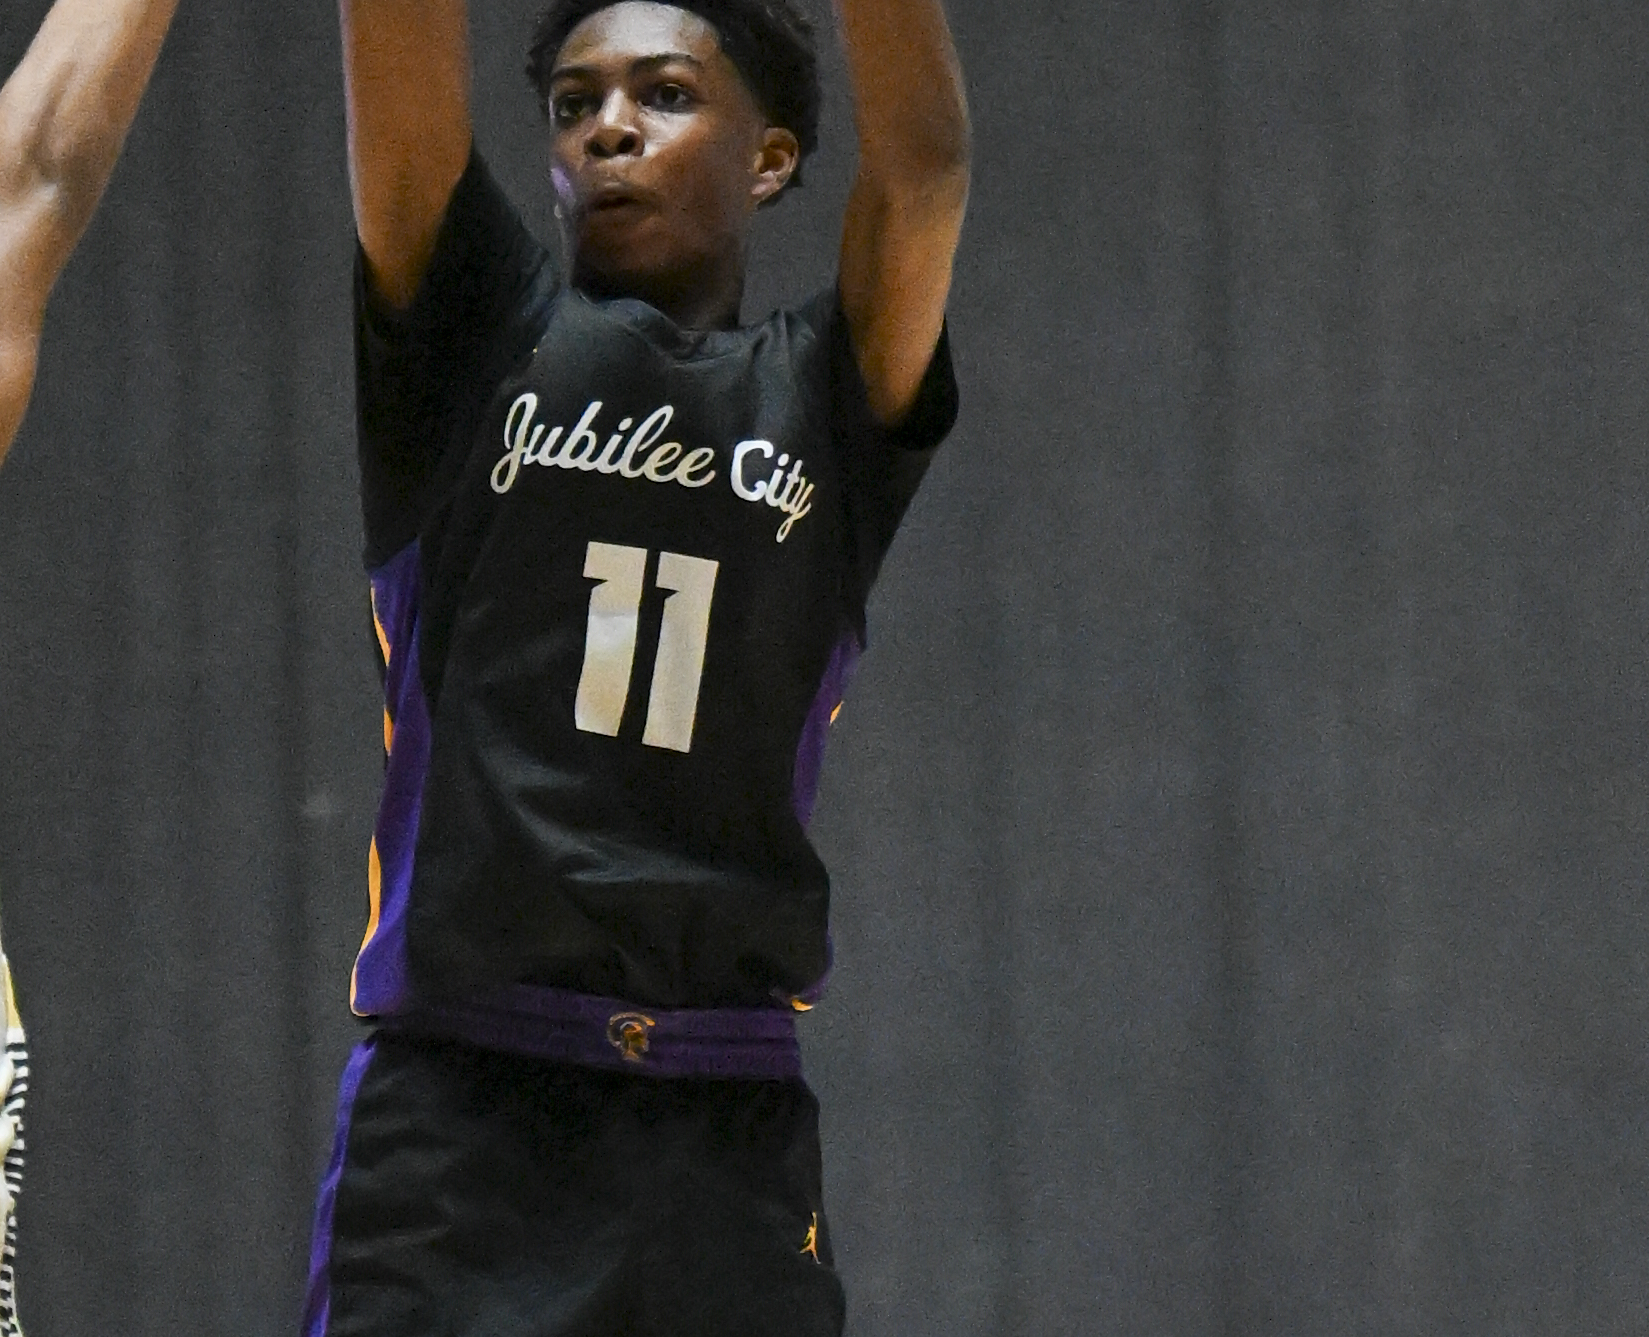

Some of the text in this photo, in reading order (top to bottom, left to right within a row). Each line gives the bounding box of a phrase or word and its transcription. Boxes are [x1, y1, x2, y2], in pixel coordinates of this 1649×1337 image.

[489, 391, 815, 543] Jubilee City
[574, 540, 720, 754] 11
